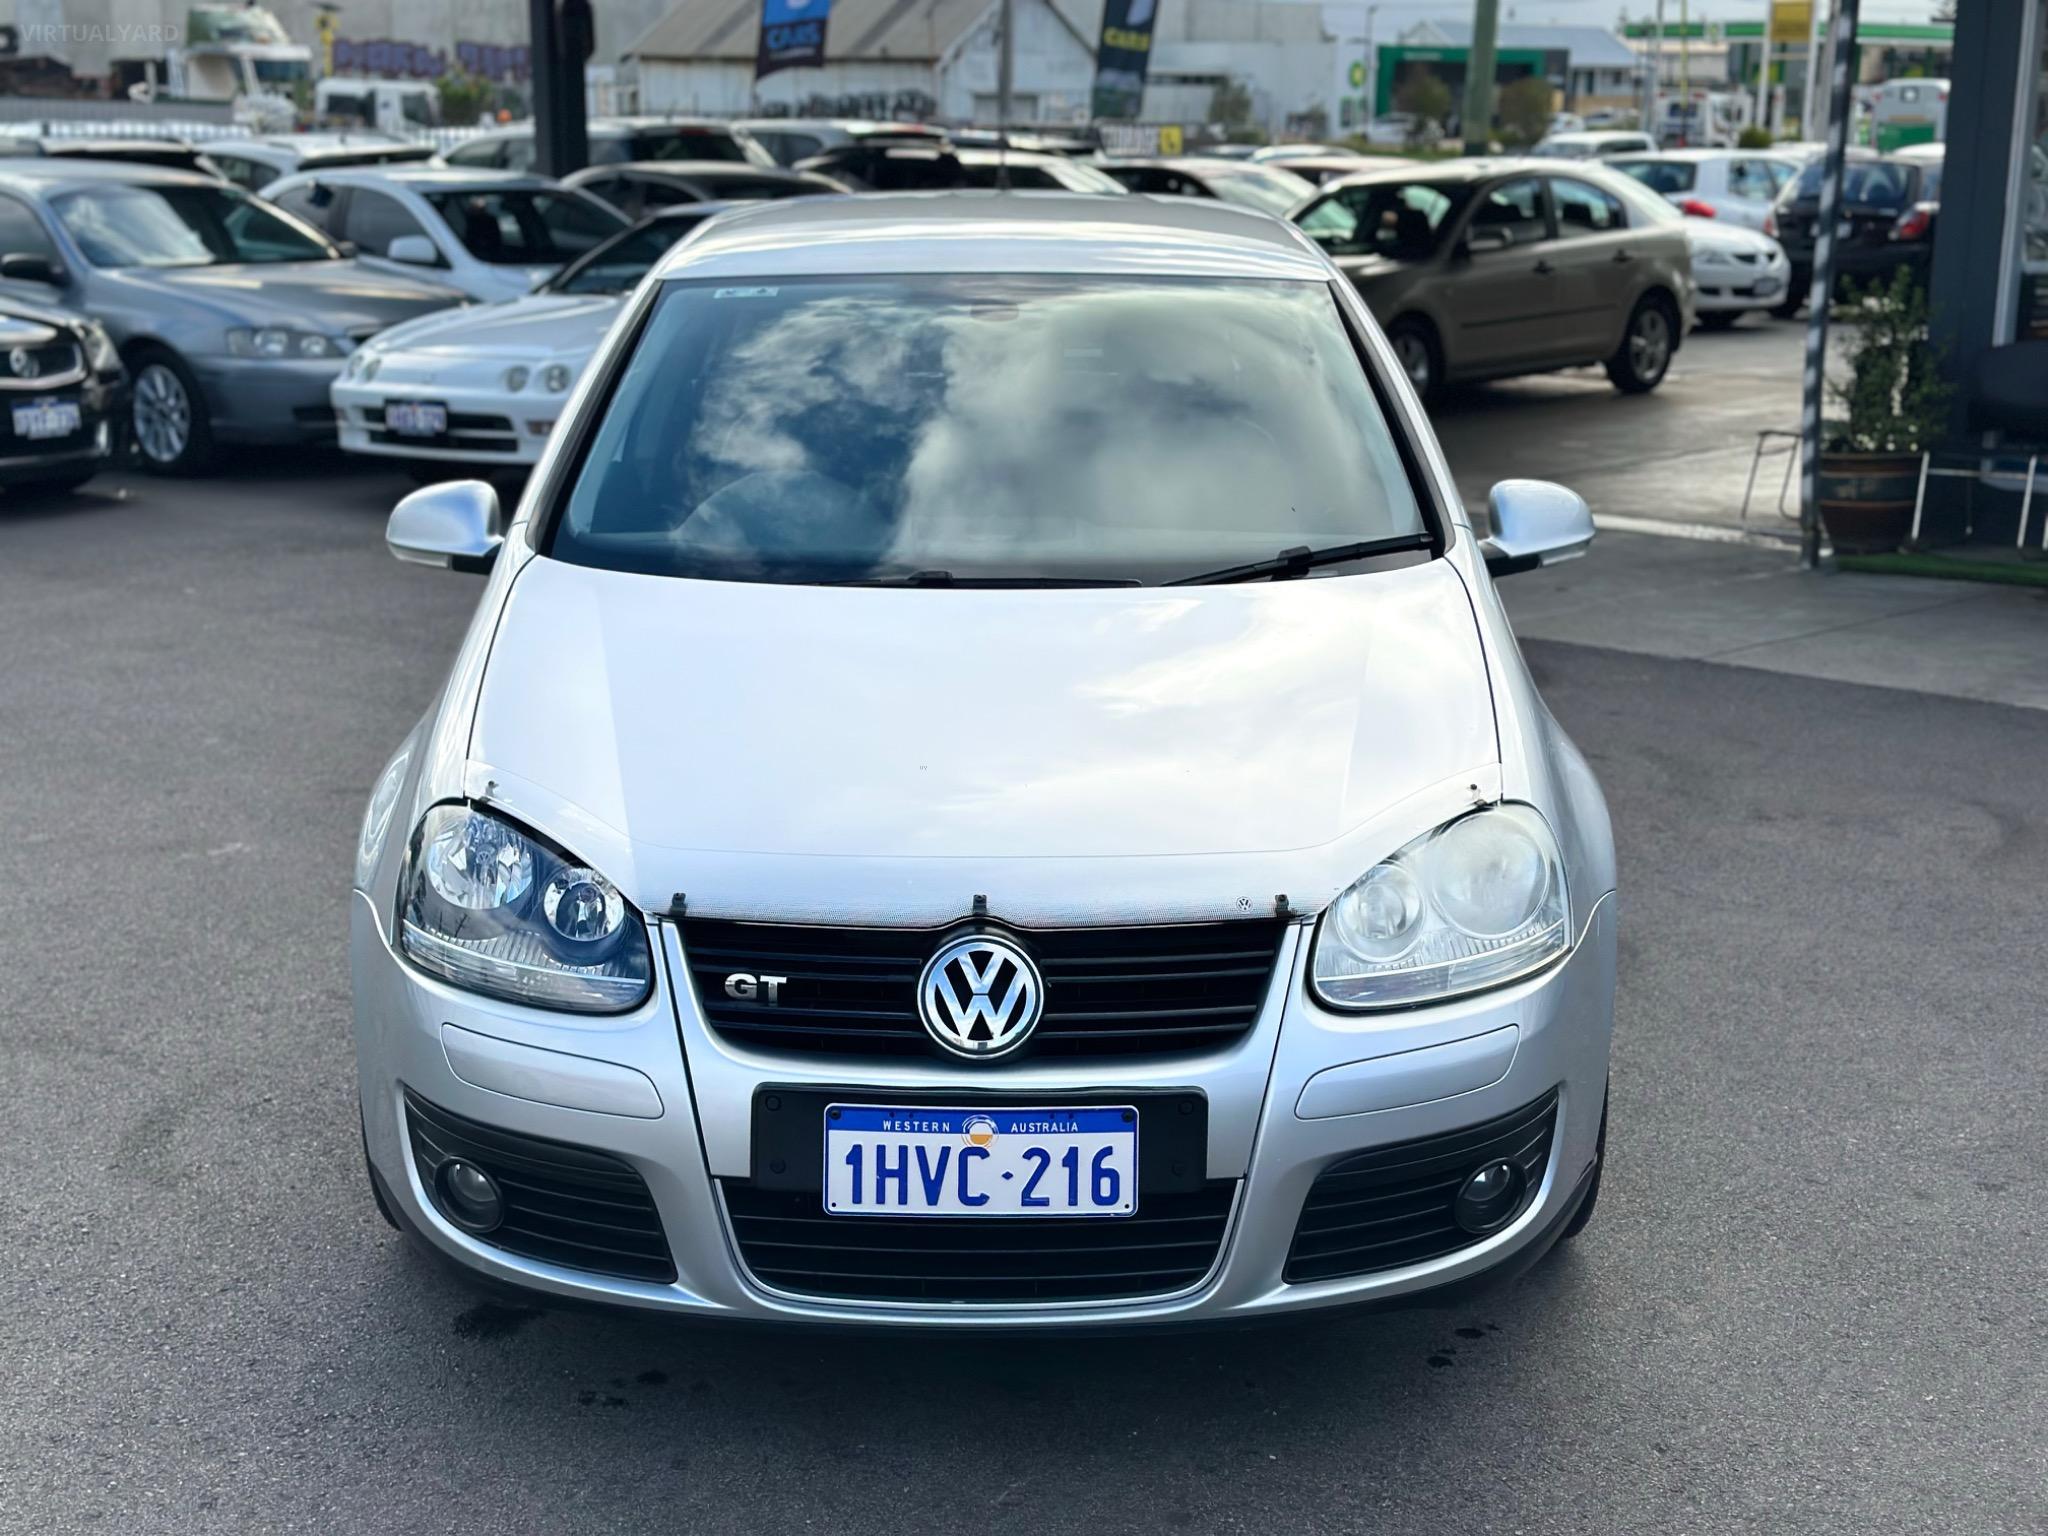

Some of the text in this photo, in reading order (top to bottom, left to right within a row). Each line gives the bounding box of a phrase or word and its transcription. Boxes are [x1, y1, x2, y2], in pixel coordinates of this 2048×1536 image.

[725, 973, 787, 1006] GT
[883, 1120, 1078, 1133] WESTERN AUSTRALIA
